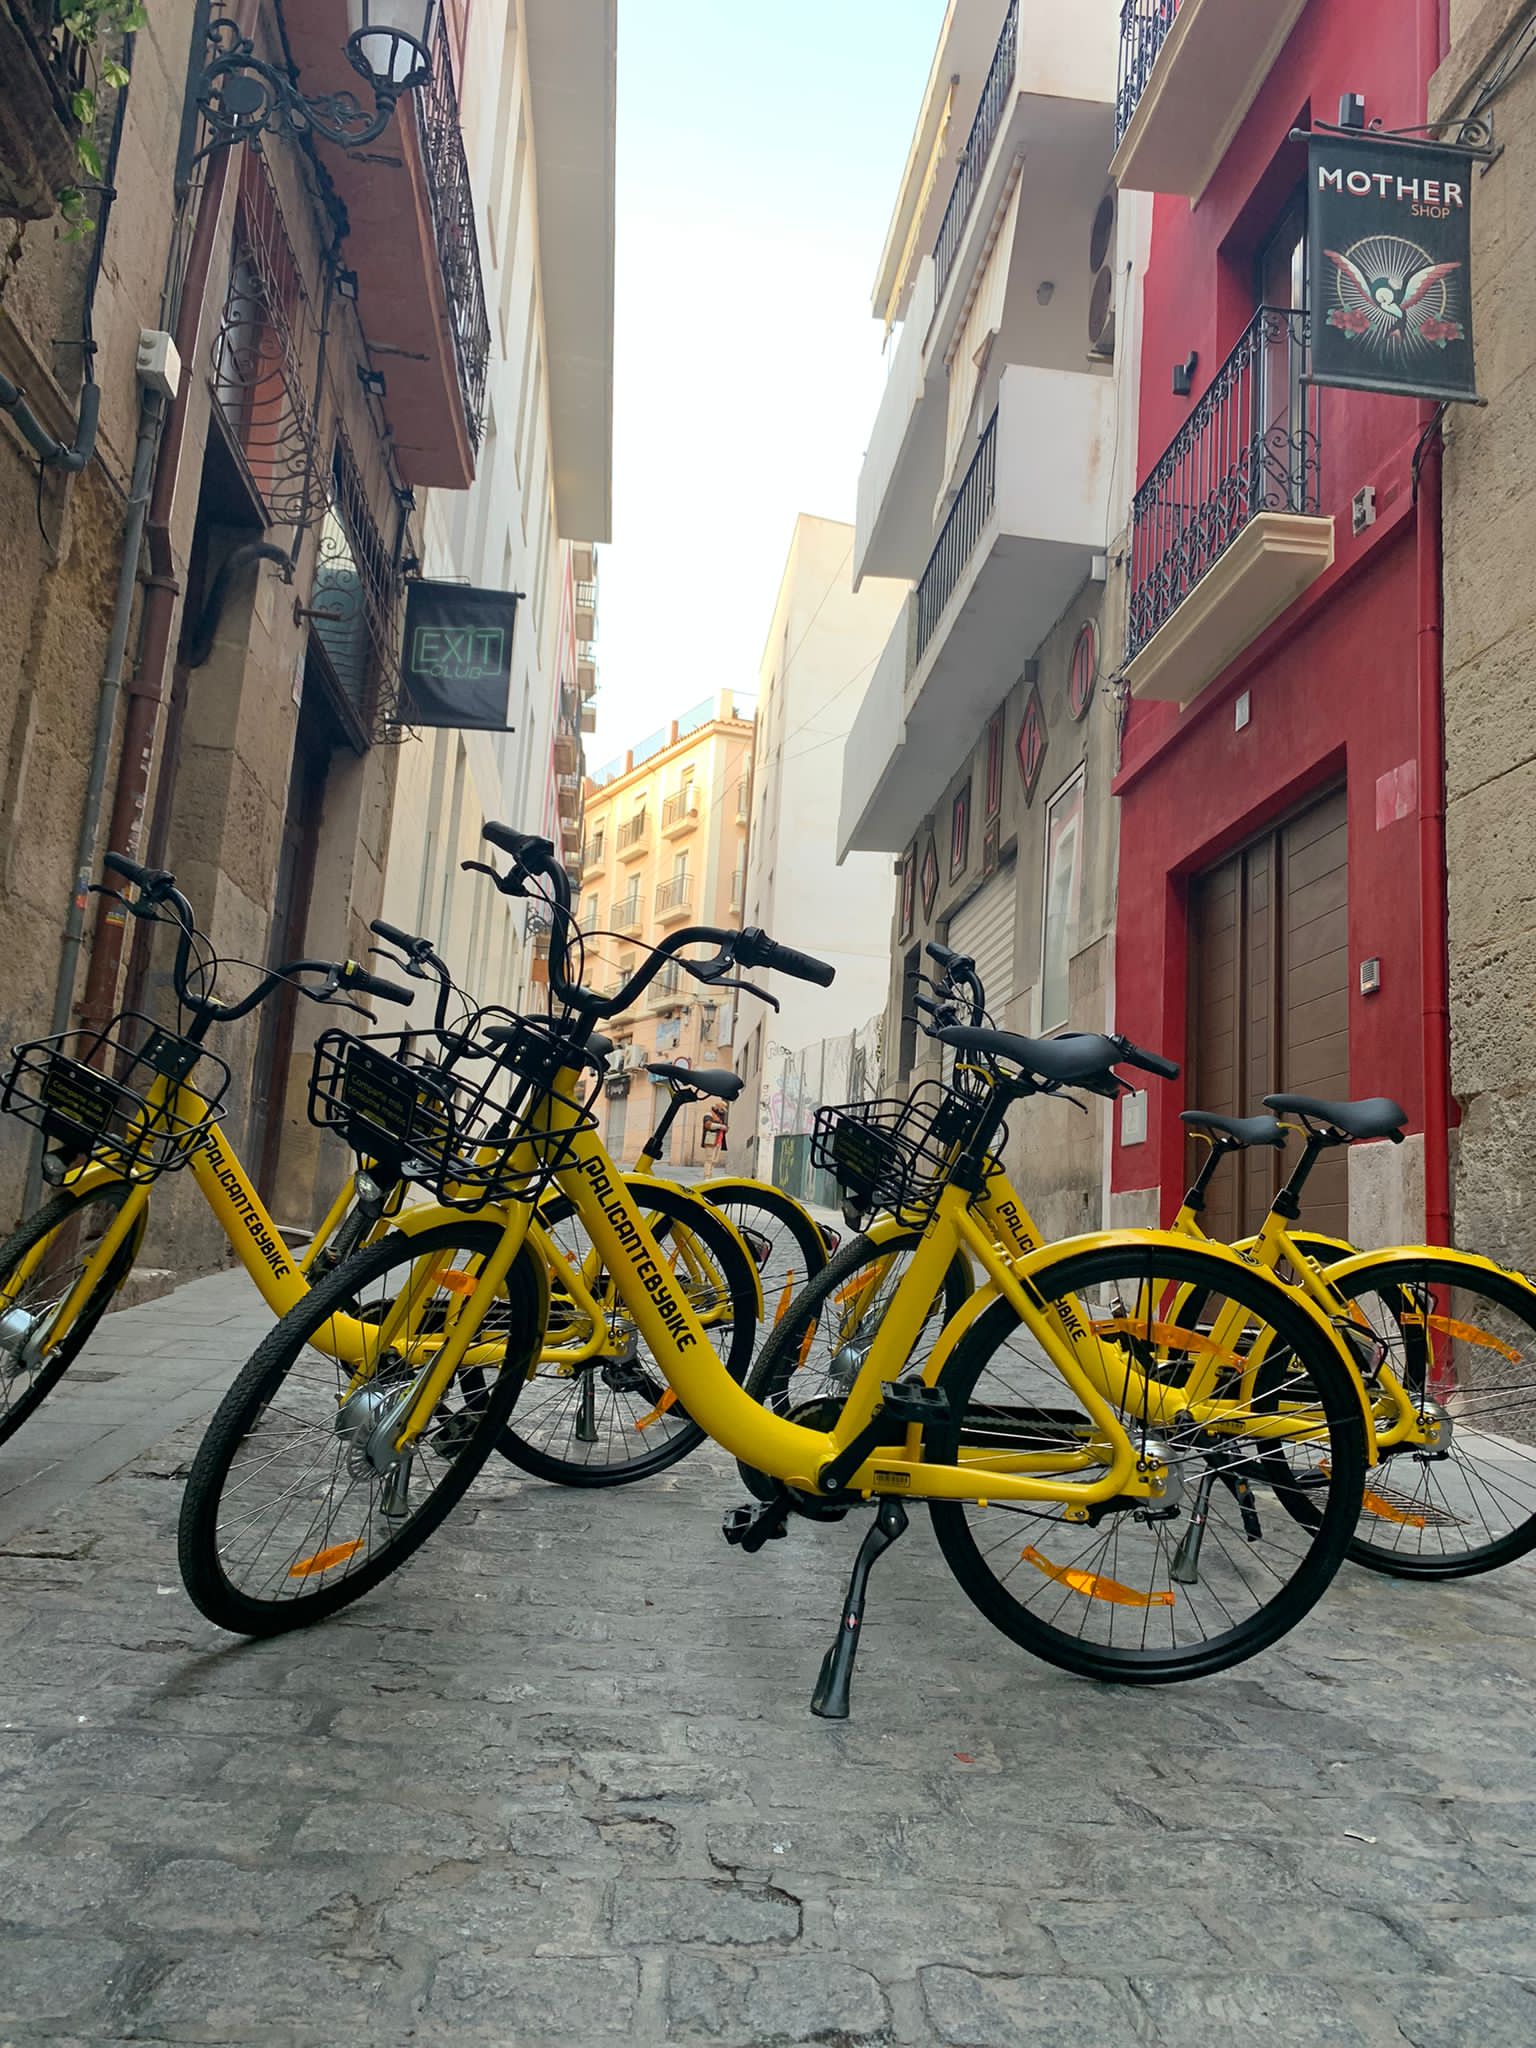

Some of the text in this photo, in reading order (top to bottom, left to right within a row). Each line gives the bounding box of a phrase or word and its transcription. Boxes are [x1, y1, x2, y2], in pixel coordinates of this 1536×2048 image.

[1318, 166, 1463, 207] MOTHER
[1411, 204, 1450, 219] SHOP
[420, 632, 500, 665] EXIT
[430, 664, 482, 679] CLUB
